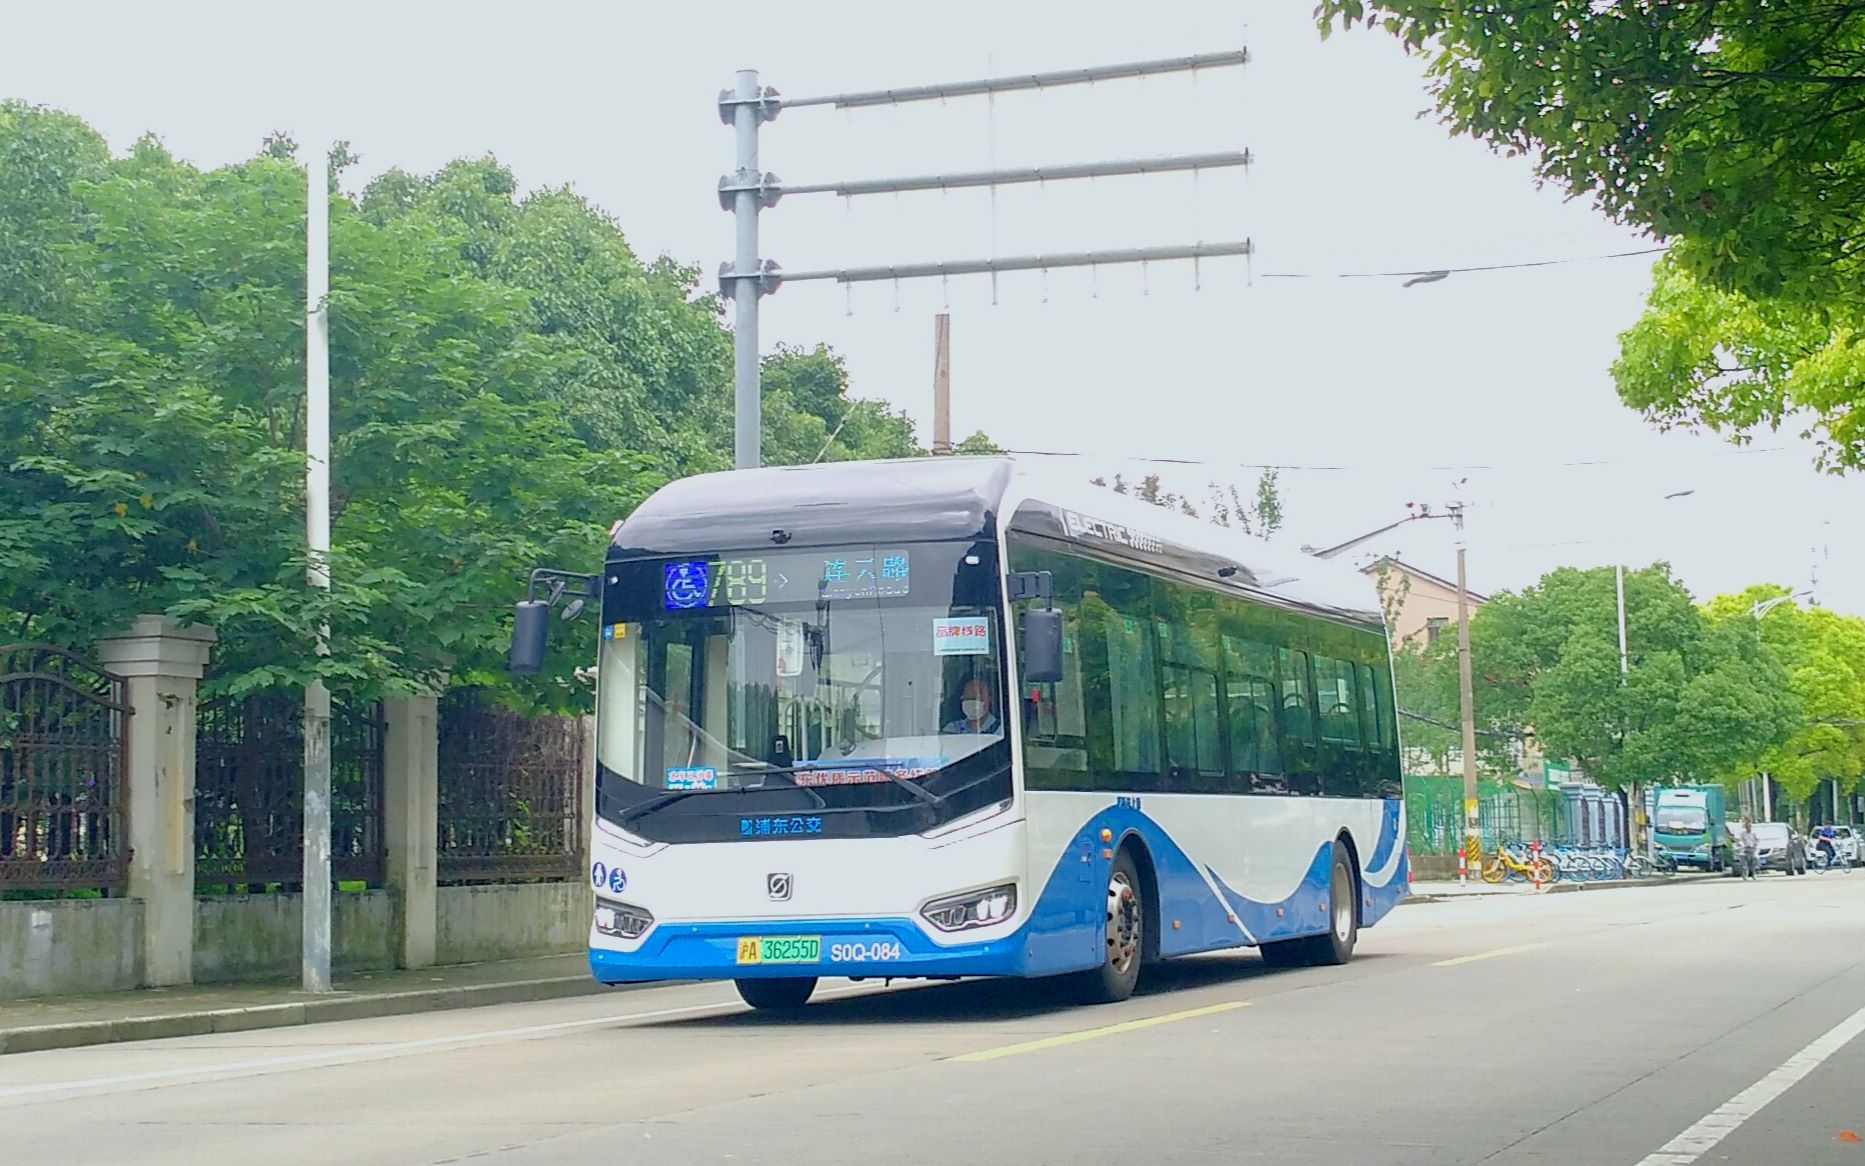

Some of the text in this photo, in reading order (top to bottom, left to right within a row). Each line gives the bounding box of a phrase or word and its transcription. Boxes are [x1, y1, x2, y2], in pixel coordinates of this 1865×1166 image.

[1066, 511, 1129, 545] ELECTRIC
[708, 559, 767, 607] 789
[755, 816, 822, 835] 浦东公交
[764, 939, 820, 960] 36255D
